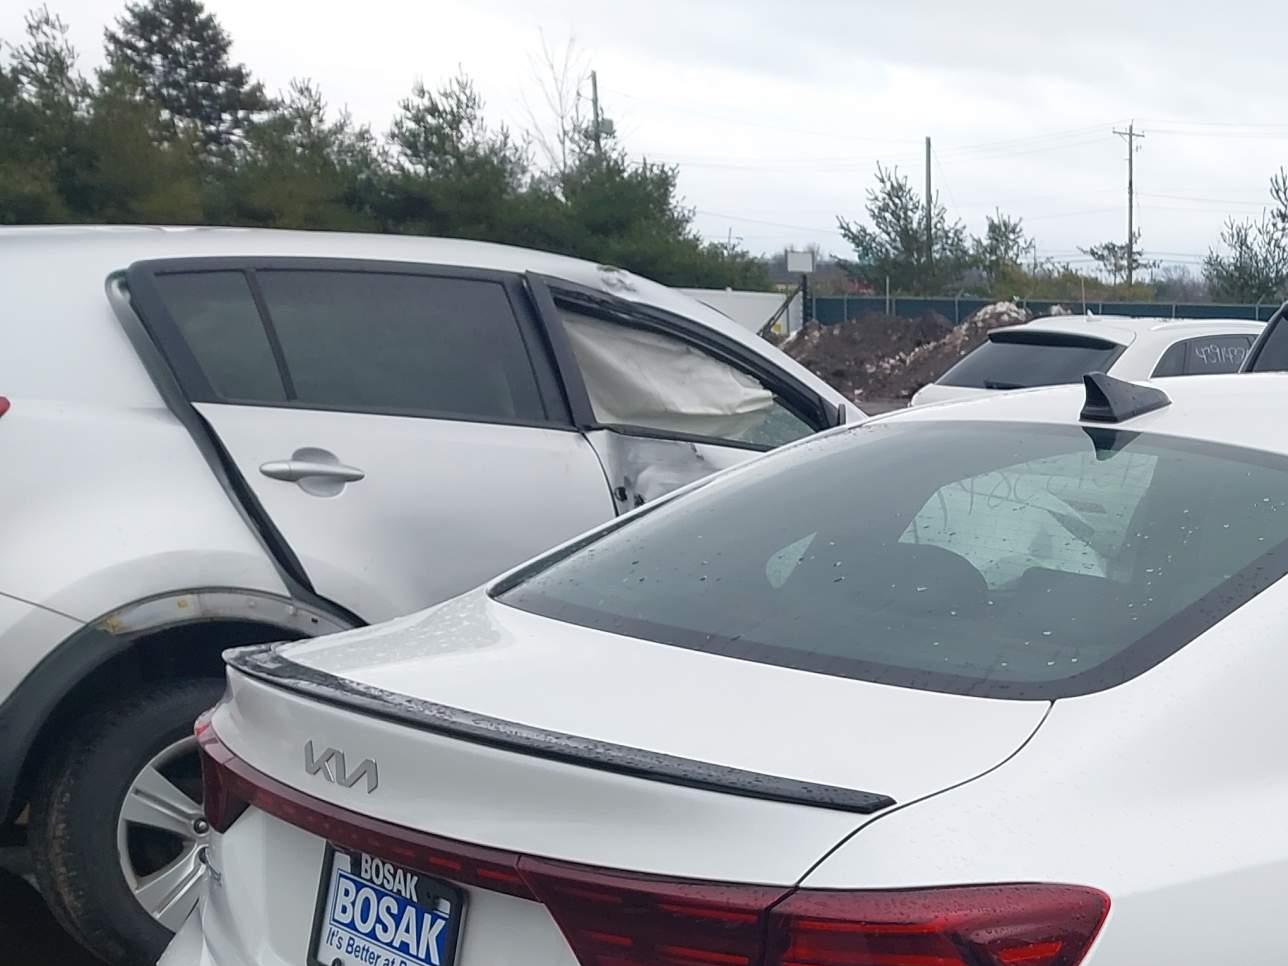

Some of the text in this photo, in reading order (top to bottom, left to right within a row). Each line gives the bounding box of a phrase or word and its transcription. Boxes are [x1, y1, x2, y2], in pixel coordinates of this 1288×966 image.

[361, 852, 419, 903] BOSAK
[325, 927, 343, 950] It's
[345, 937, 381, 966] Better
[333, 877, 446, 966] BOSAK
